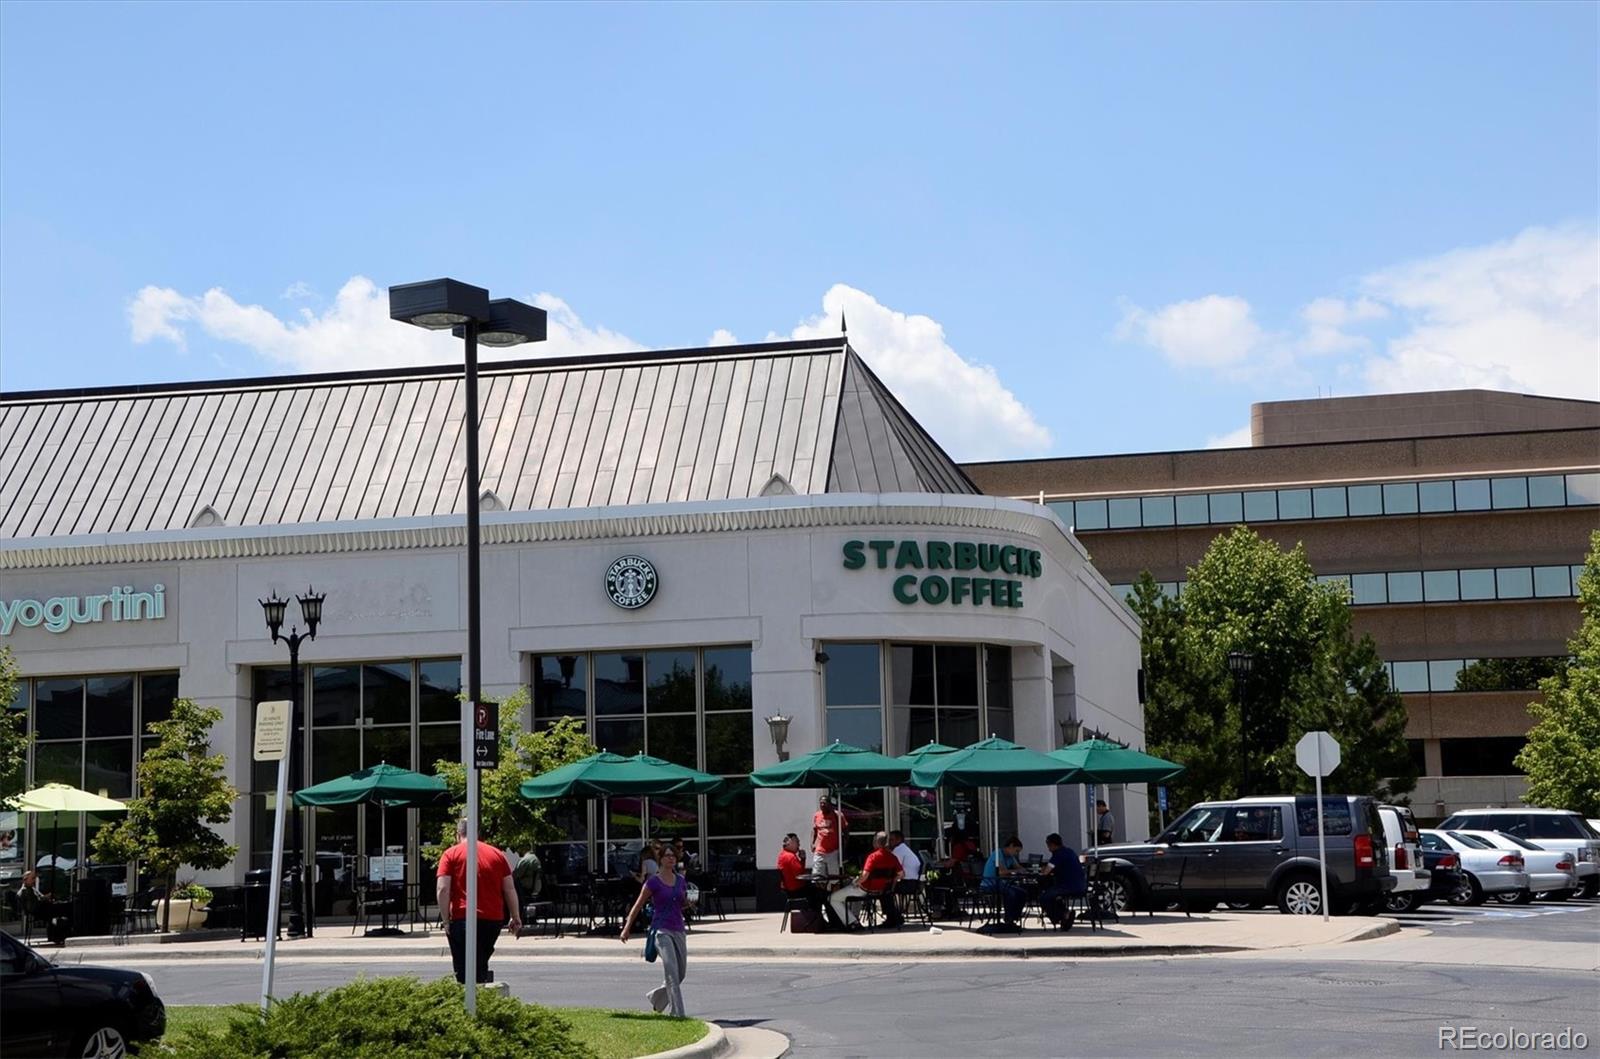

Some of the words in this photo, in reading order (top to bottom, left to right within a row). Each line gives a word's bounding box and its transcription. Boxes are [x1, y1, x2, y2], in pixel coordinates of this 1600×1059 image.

[607, 558, 653, 582] STARBUCKS
[843, 540, 1042, 578] STARBUCKS
[613, 592, 648, 606] COFFEE
[893, 575, 1023, 608] COFFEE
[0, 584, 166, 636] yogurtini
